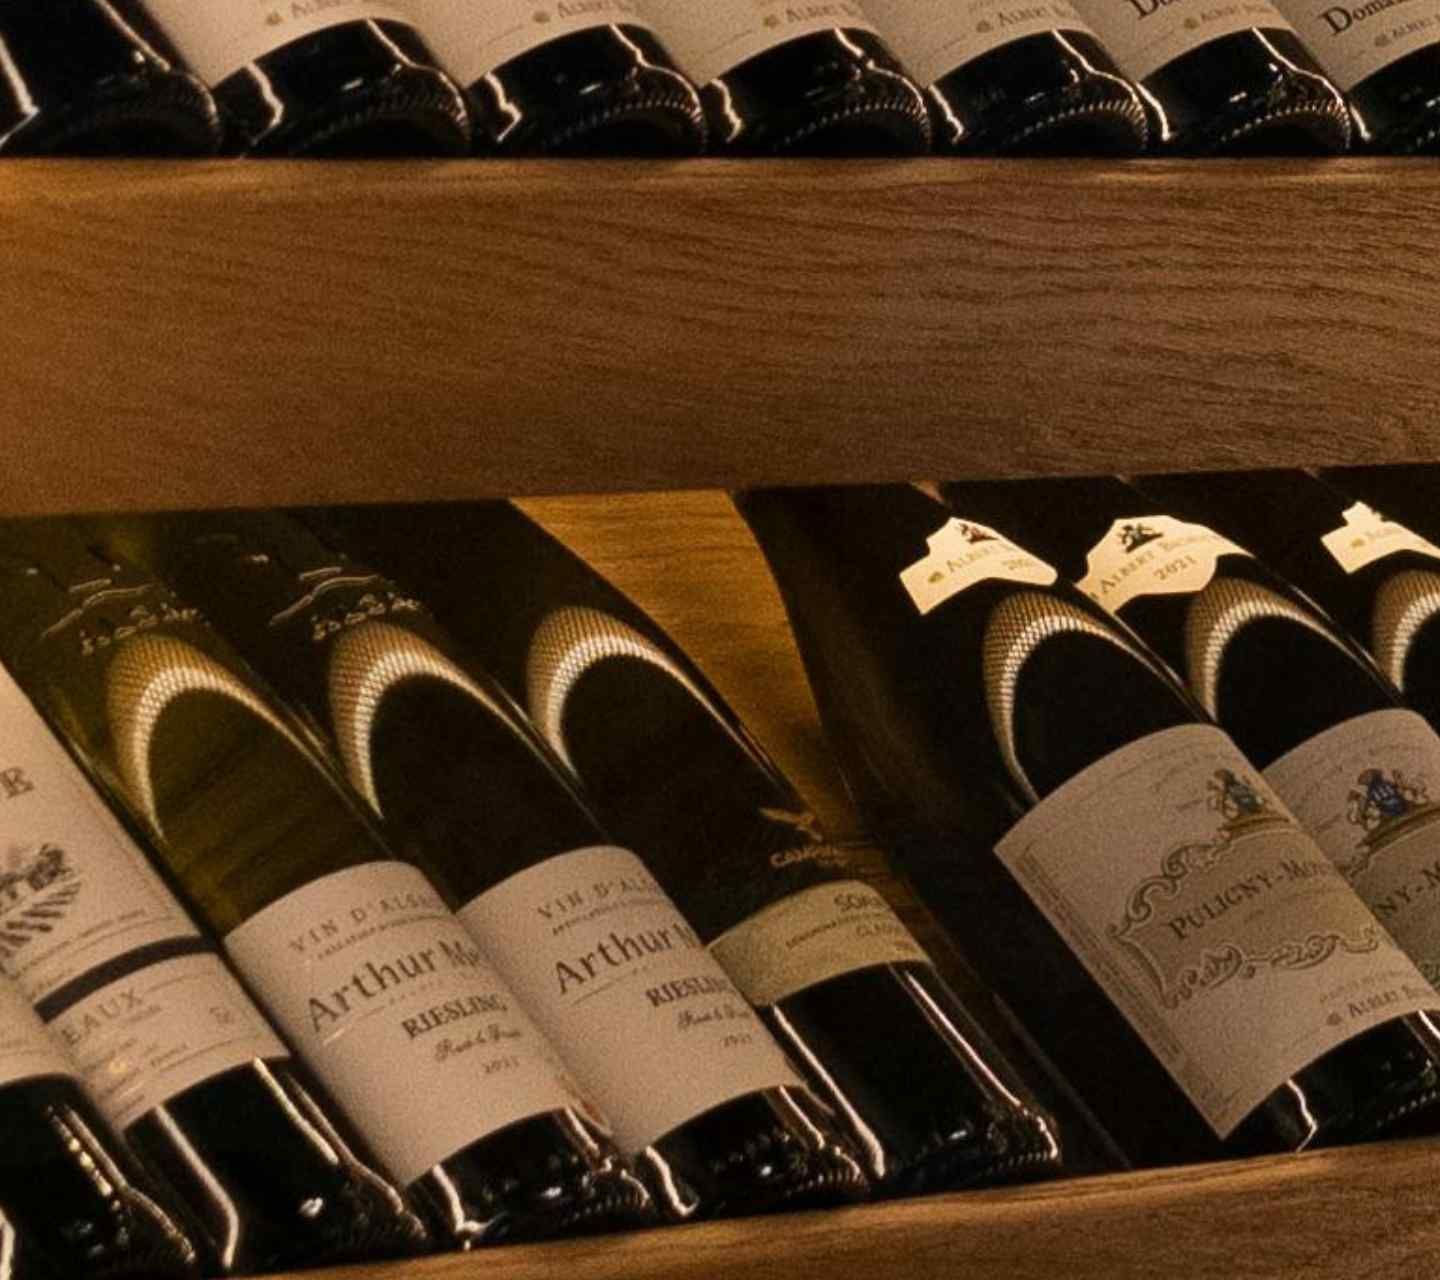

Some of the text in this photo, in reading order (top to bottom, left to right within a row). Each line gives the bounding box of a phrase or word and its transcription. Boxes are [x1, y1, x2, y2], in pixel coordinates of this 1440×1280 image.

[287, 918, 339, 953] VIN
[549, 924, 672, 994] Arthur
[306, 940, 437, 1033] Arthur
[400, 992, 509, 1040] RIESLING
